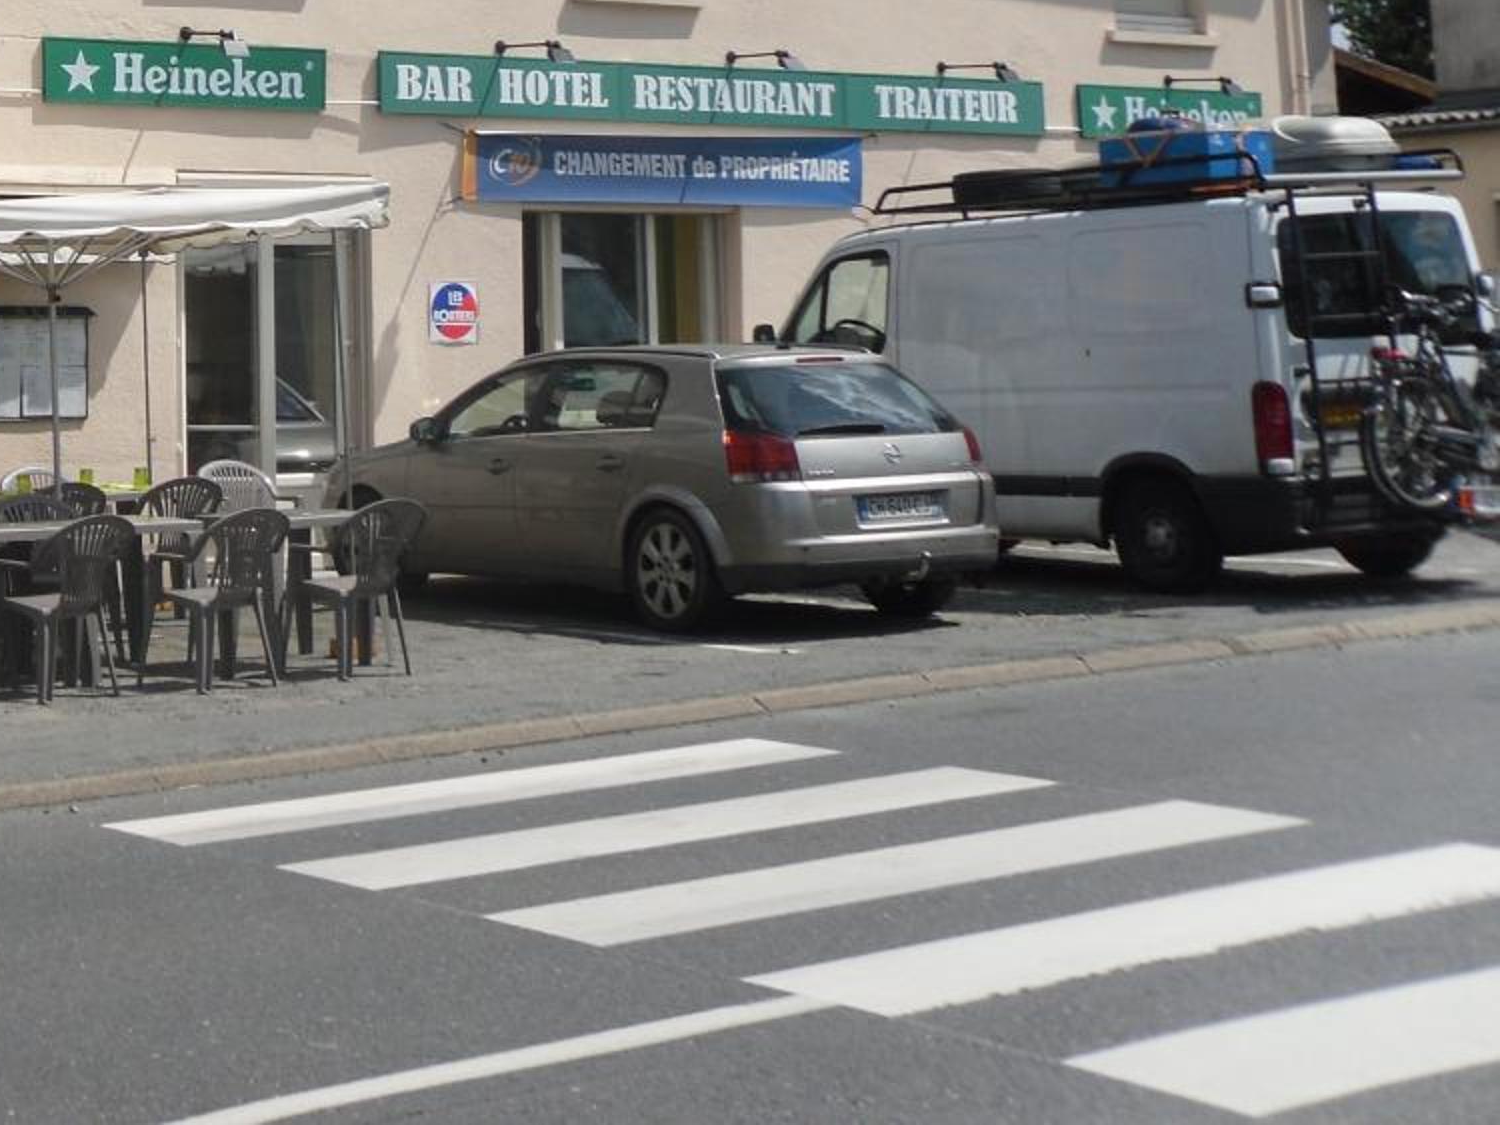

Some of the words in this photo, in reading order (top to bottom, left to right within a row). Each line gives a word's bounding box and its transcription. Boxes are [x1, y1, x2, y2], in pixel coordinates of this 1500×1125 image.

[112, 51, 305, 100] Heineken
[395, 64, 474, 103] BAR
[497, 67, 610, 108] HOTEL
[632, 74, 837, 117] RESTAURANT
[874, 84, 1019, 124] TRAITEUR
[553, 150, 687, 179] CHANGEMENT
[692, 154, 717, 178] de
[719, 150, 851, 183] PROPRIÉTAIRE
